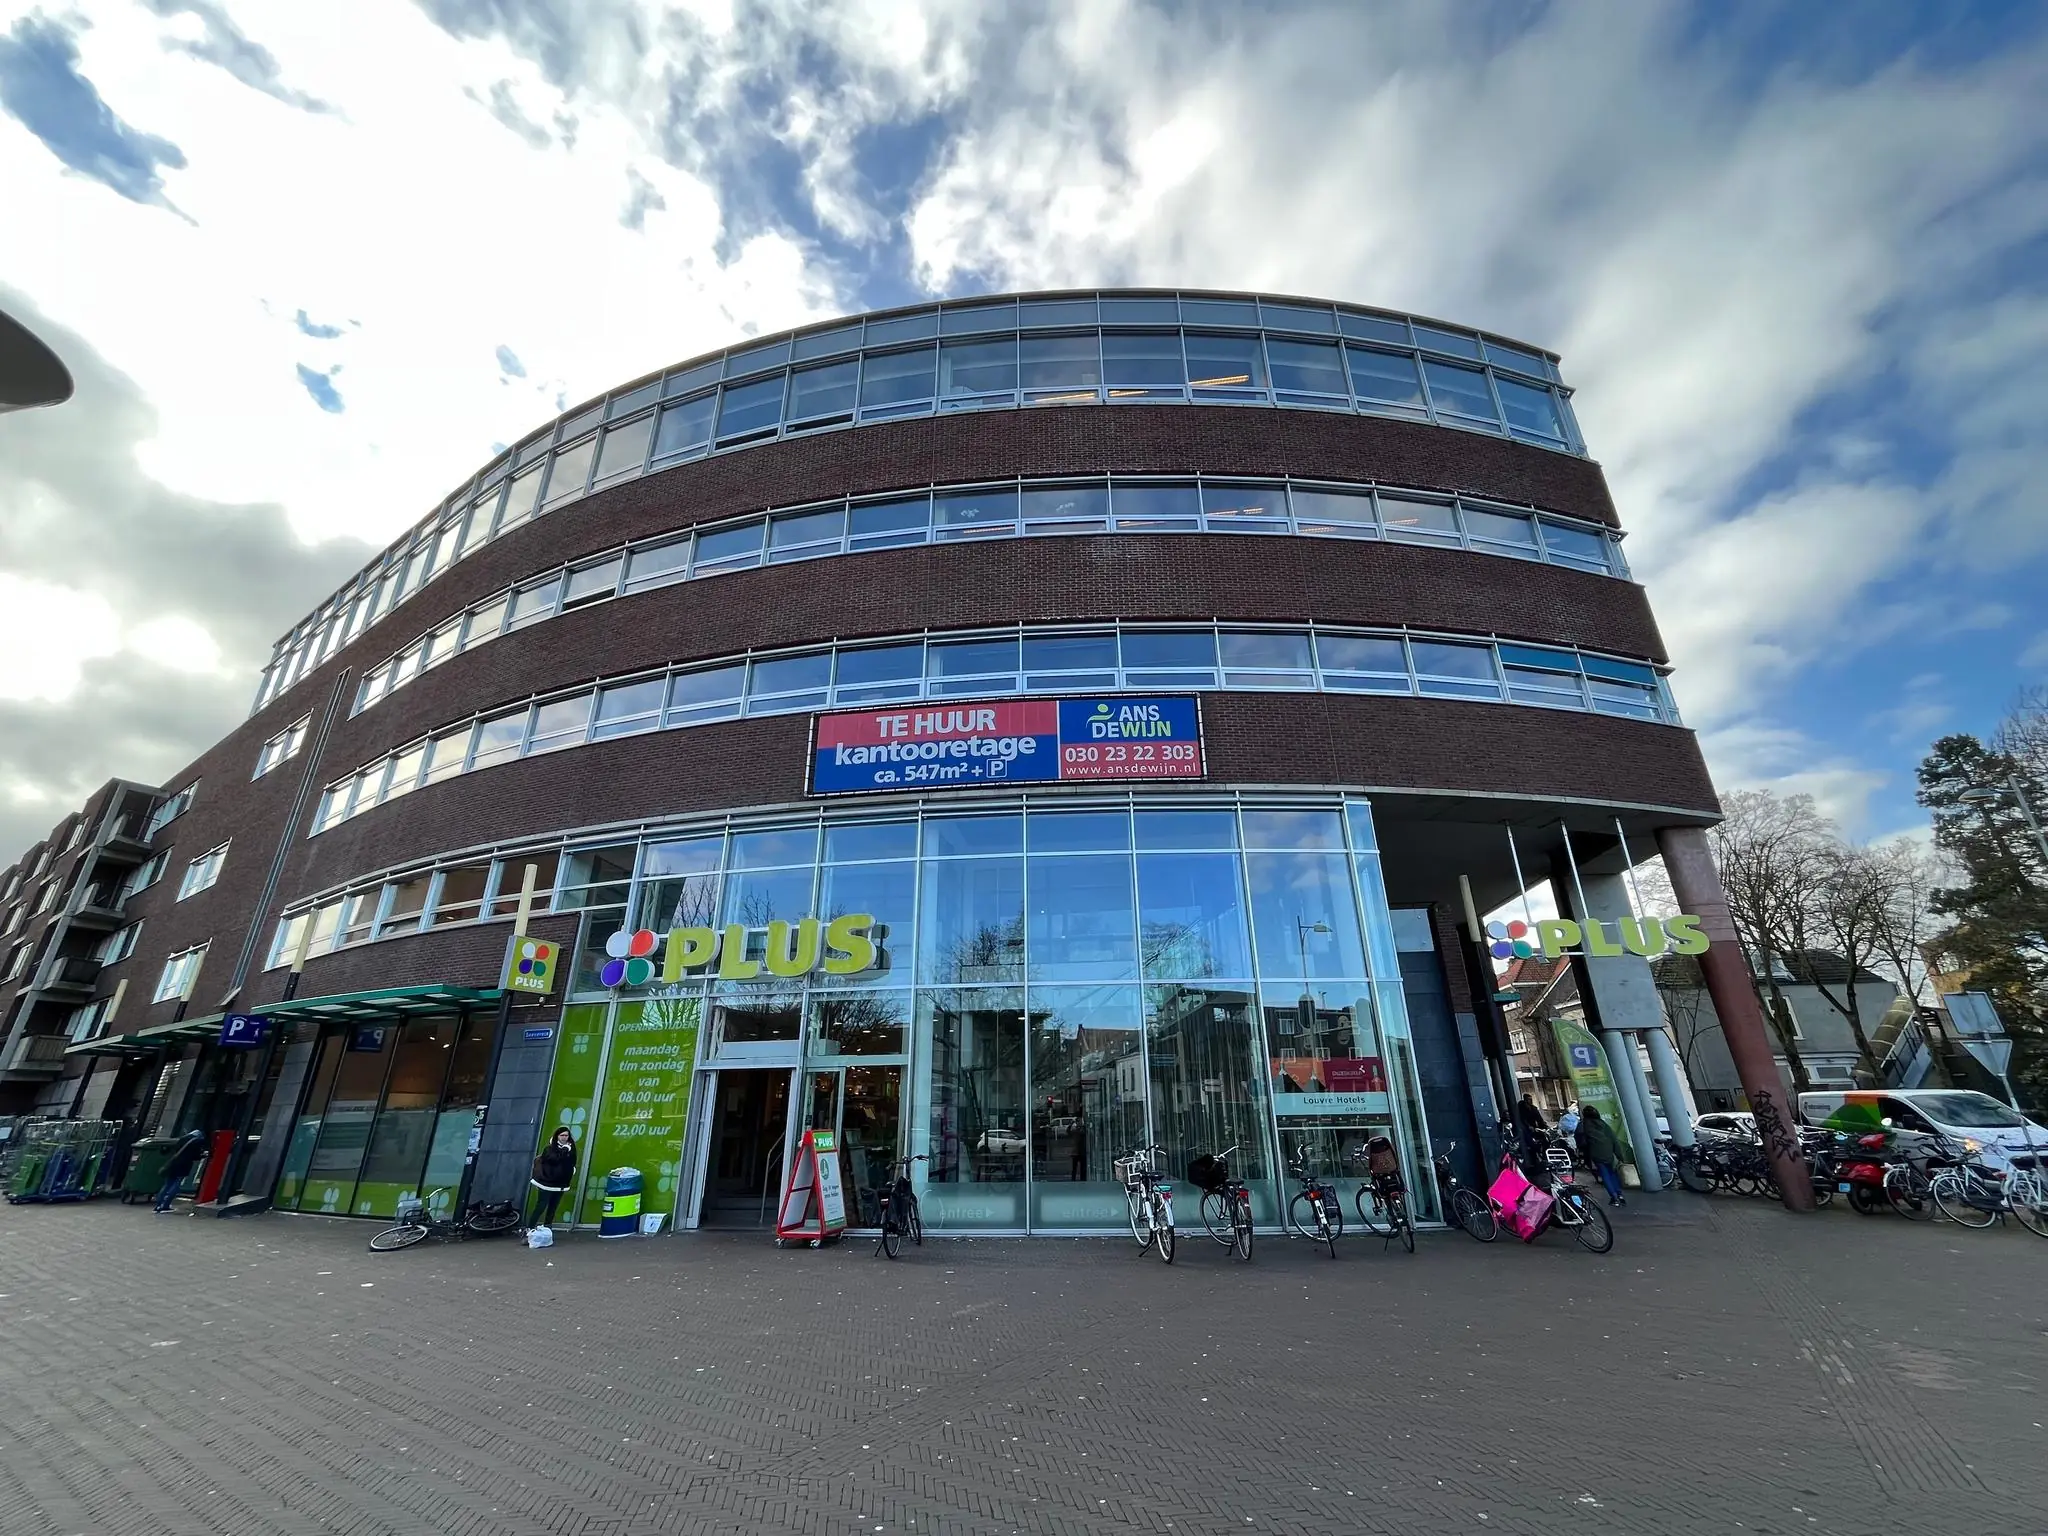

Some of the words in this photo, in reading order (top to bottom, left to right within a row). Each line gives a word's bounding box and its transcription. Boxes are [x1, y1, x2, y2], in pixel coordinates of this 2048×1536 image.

[1119, 705, 1160, 721] ANS
[876, 715, 908, 738] TE
[914, 709, 996, 735] HUUR
[1092, 721, 1172, 738] DEWIJN
[835, 735, 1036, 765] kantooretage
[1065, 747, 1099, 763] 030
[1105, 746, 1127, 761] 23
[1133, 745, 1155, 761] 22
[1161, 745, 1195, 760] 303
[874, 769, 900, 783] ca.
[904, 762, 968, 782] 547m²
[990, 760, 1005, 776] P
[1066, 762, 1197, 775] www.ansdewijn.nl
[1536, 914, 1711, 958] PLUS
[662, 913, 877, 984] PLUS
[515, 976, 545, 989] PLUS
[228, 1019, 245, 1037] P
[624, 1044, 680, 1056] maandag
[641, 1058, 686, 1072] zondag
[638, 1077, 660, 1087] van
[619, 1091, 651, 1103] 08.00
[653, 1092, 675, 1102] uur
[1303, 1096, 1333, 1104] Louvre
[1336, 1095, 1366, 1104] Hotels
[635, 1107, 654, 1118] tot
[613, 1124, 646, 1136] 22.00
[648, 1125, 671, 1136] uur
[817, 1136, 833, 1147] PLUS
